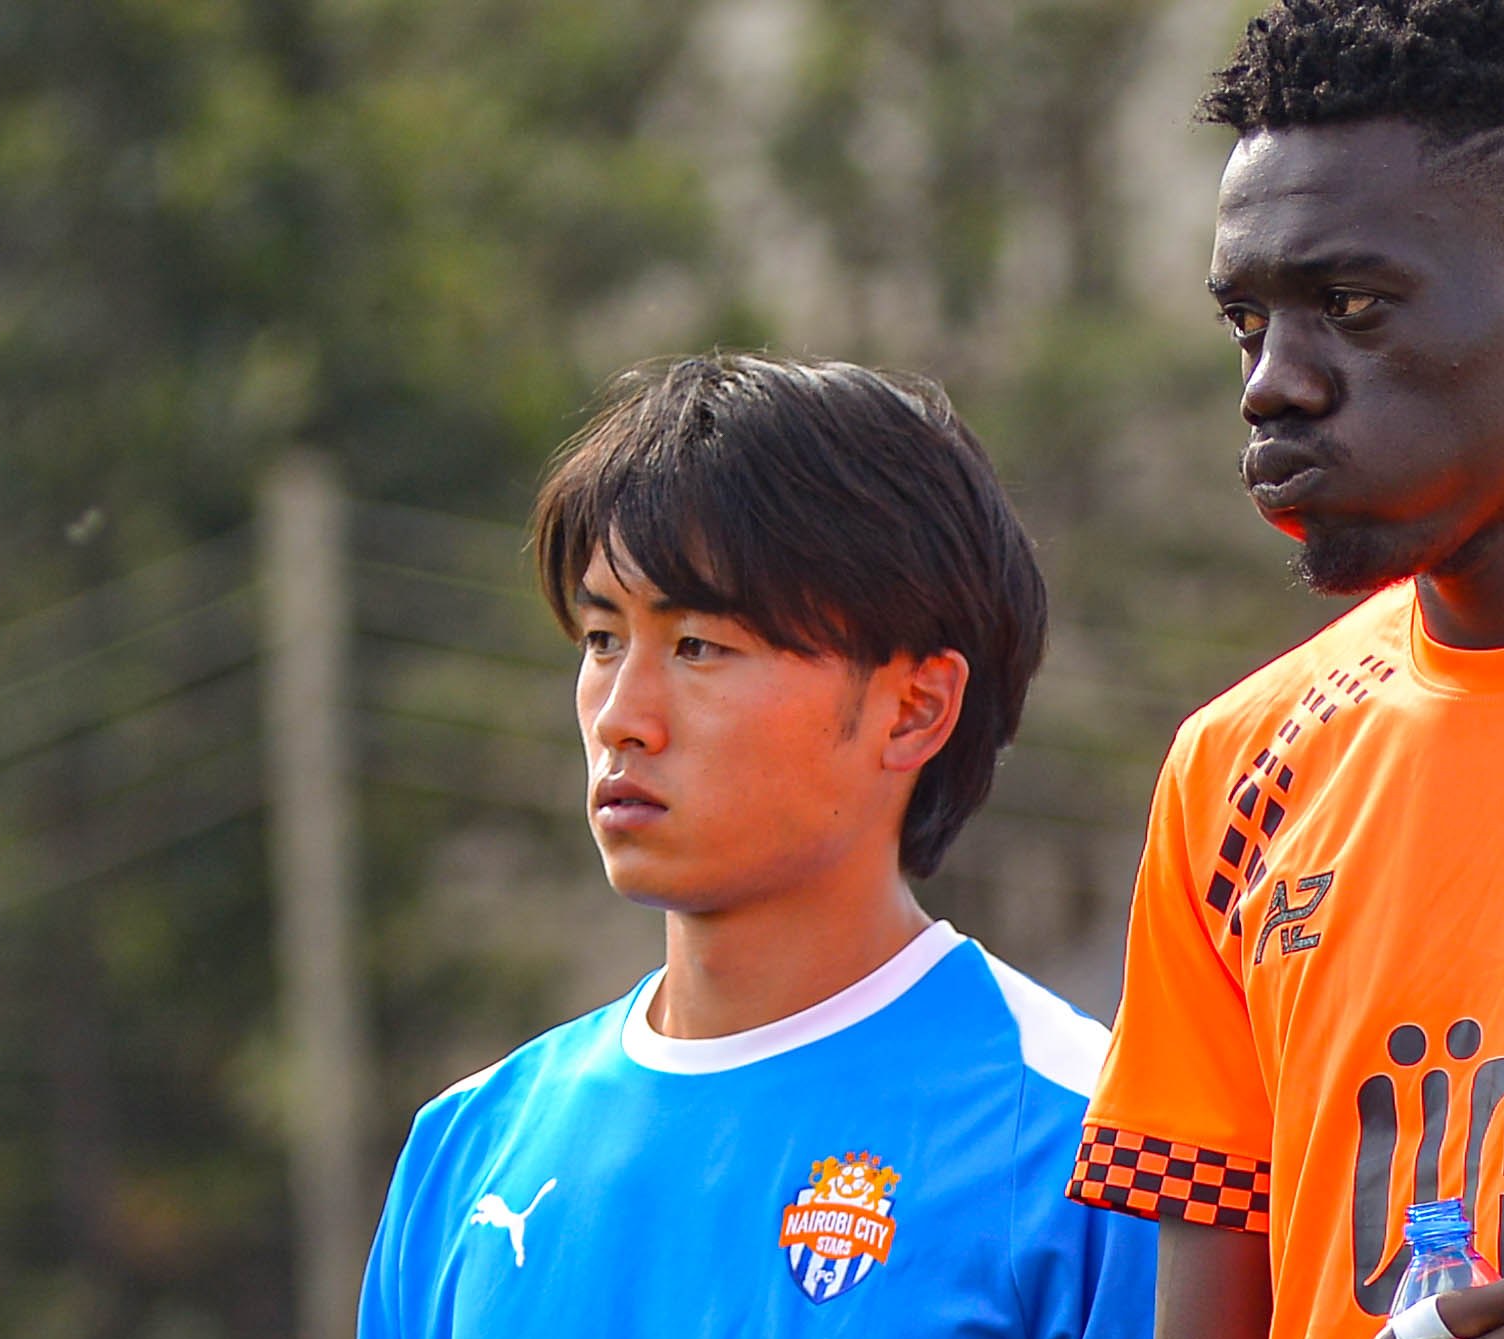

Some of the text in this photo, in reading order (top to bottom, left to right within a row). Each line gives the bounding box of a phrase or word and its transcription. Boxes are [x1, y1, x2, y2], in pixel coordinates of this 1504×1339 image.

[785, 1210, 889, 1249] NAIROBI CITY
[815, 1236, 852, 1255] STARS
[816, 1269, 834, 1282] FC
